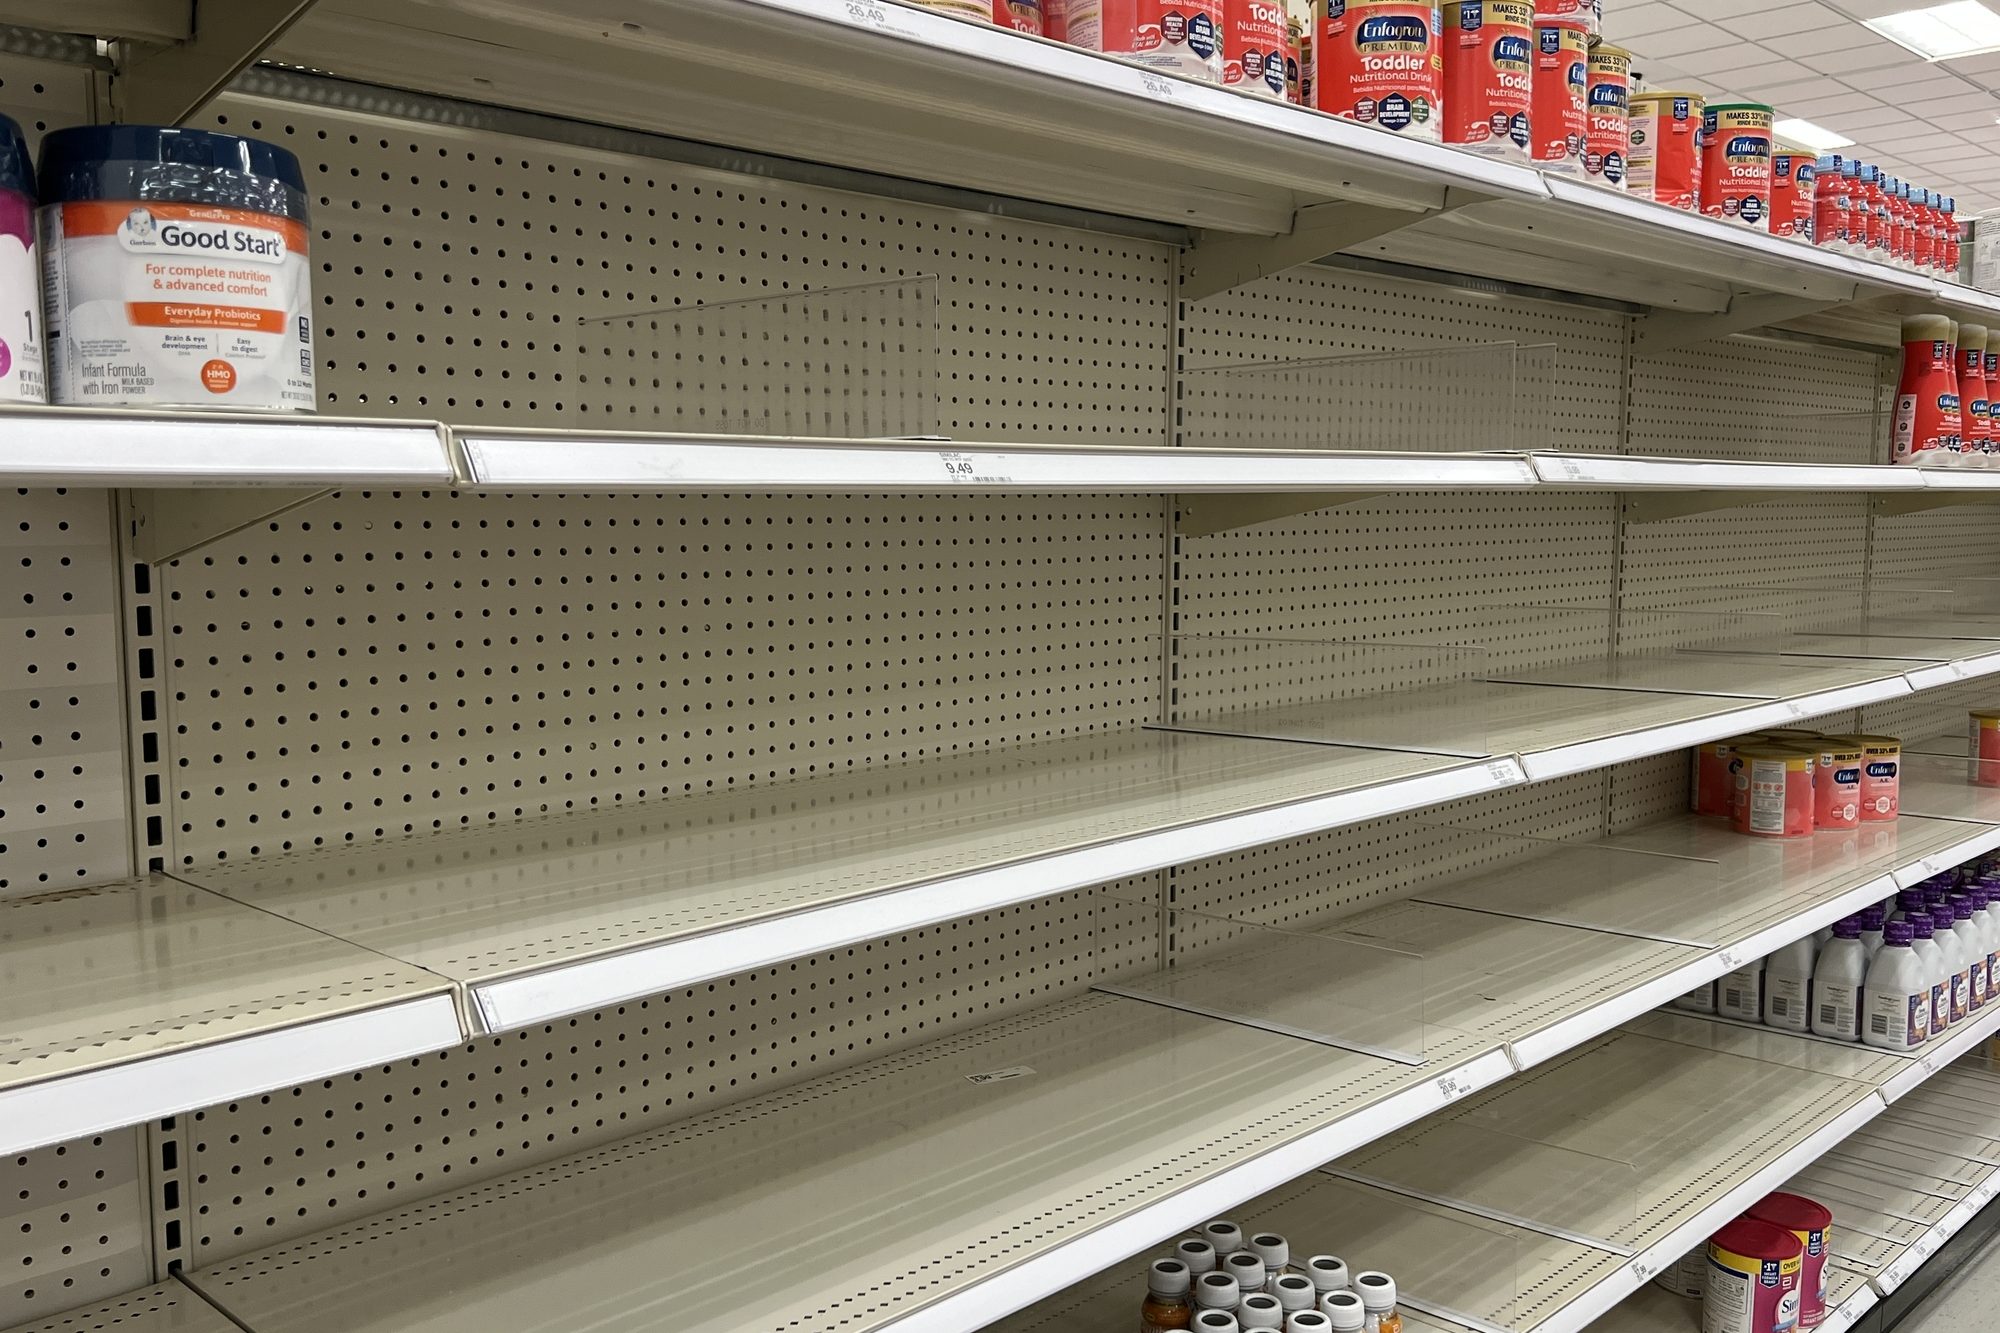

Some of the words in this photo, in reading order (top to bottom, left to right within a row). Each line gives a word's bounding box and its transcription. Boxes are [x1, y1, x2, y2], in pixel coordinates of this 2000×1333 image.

[846, 3, 885, 22] 26.49
[1493, 4, 1518, 14] MAKES
[1195, 25, 1211, 35] BRAIN
[1364, 21, 1423, 39] Enfagrow
[1363, 42, 1422, 52] PREMIUM
[1361, 55, 1425, 71] Toddler
[1588, 56, 1611, 65] MAKES
[1350, 72, 1408, 84] Nutritional
[1411, 72, 1432, 83] Drink
[1726, 112, 1750, 120] MAKES
[1720, 178, 1760, 186] Nutritional
[161, 225, 229, 250] Good
[234, 231, 280, 257] Start
[146, 264, 165, 275] For
[169, 265, 225, 278] complete
[229, 270, 271, 282] nutrition
[153, 279, 162, 289] &
[166, 279, 224, 292] advanced
[227, 284, 267, 297] comfort
[164, 306, 211, 320] Everyday
[214, 308, 261, 321] Probiotics
[25, 310, 33, 342] 1
[161, 342, 208, 352] development
[240, 345, 258, 354] digest
[82, 363, 105, 377] Infant
[107, 363, 146, 377] Formula
[207, 369, 231, 379] HMO
[121, 377, 135, 385] MILK
[136, 377, 155, 385] BASED
[83, 381, 100, 395] with
[102, 380, 118, 394] Iron
[122, 386, 146, 394] POWDER
[946, 462, 973, 475] 9.49
